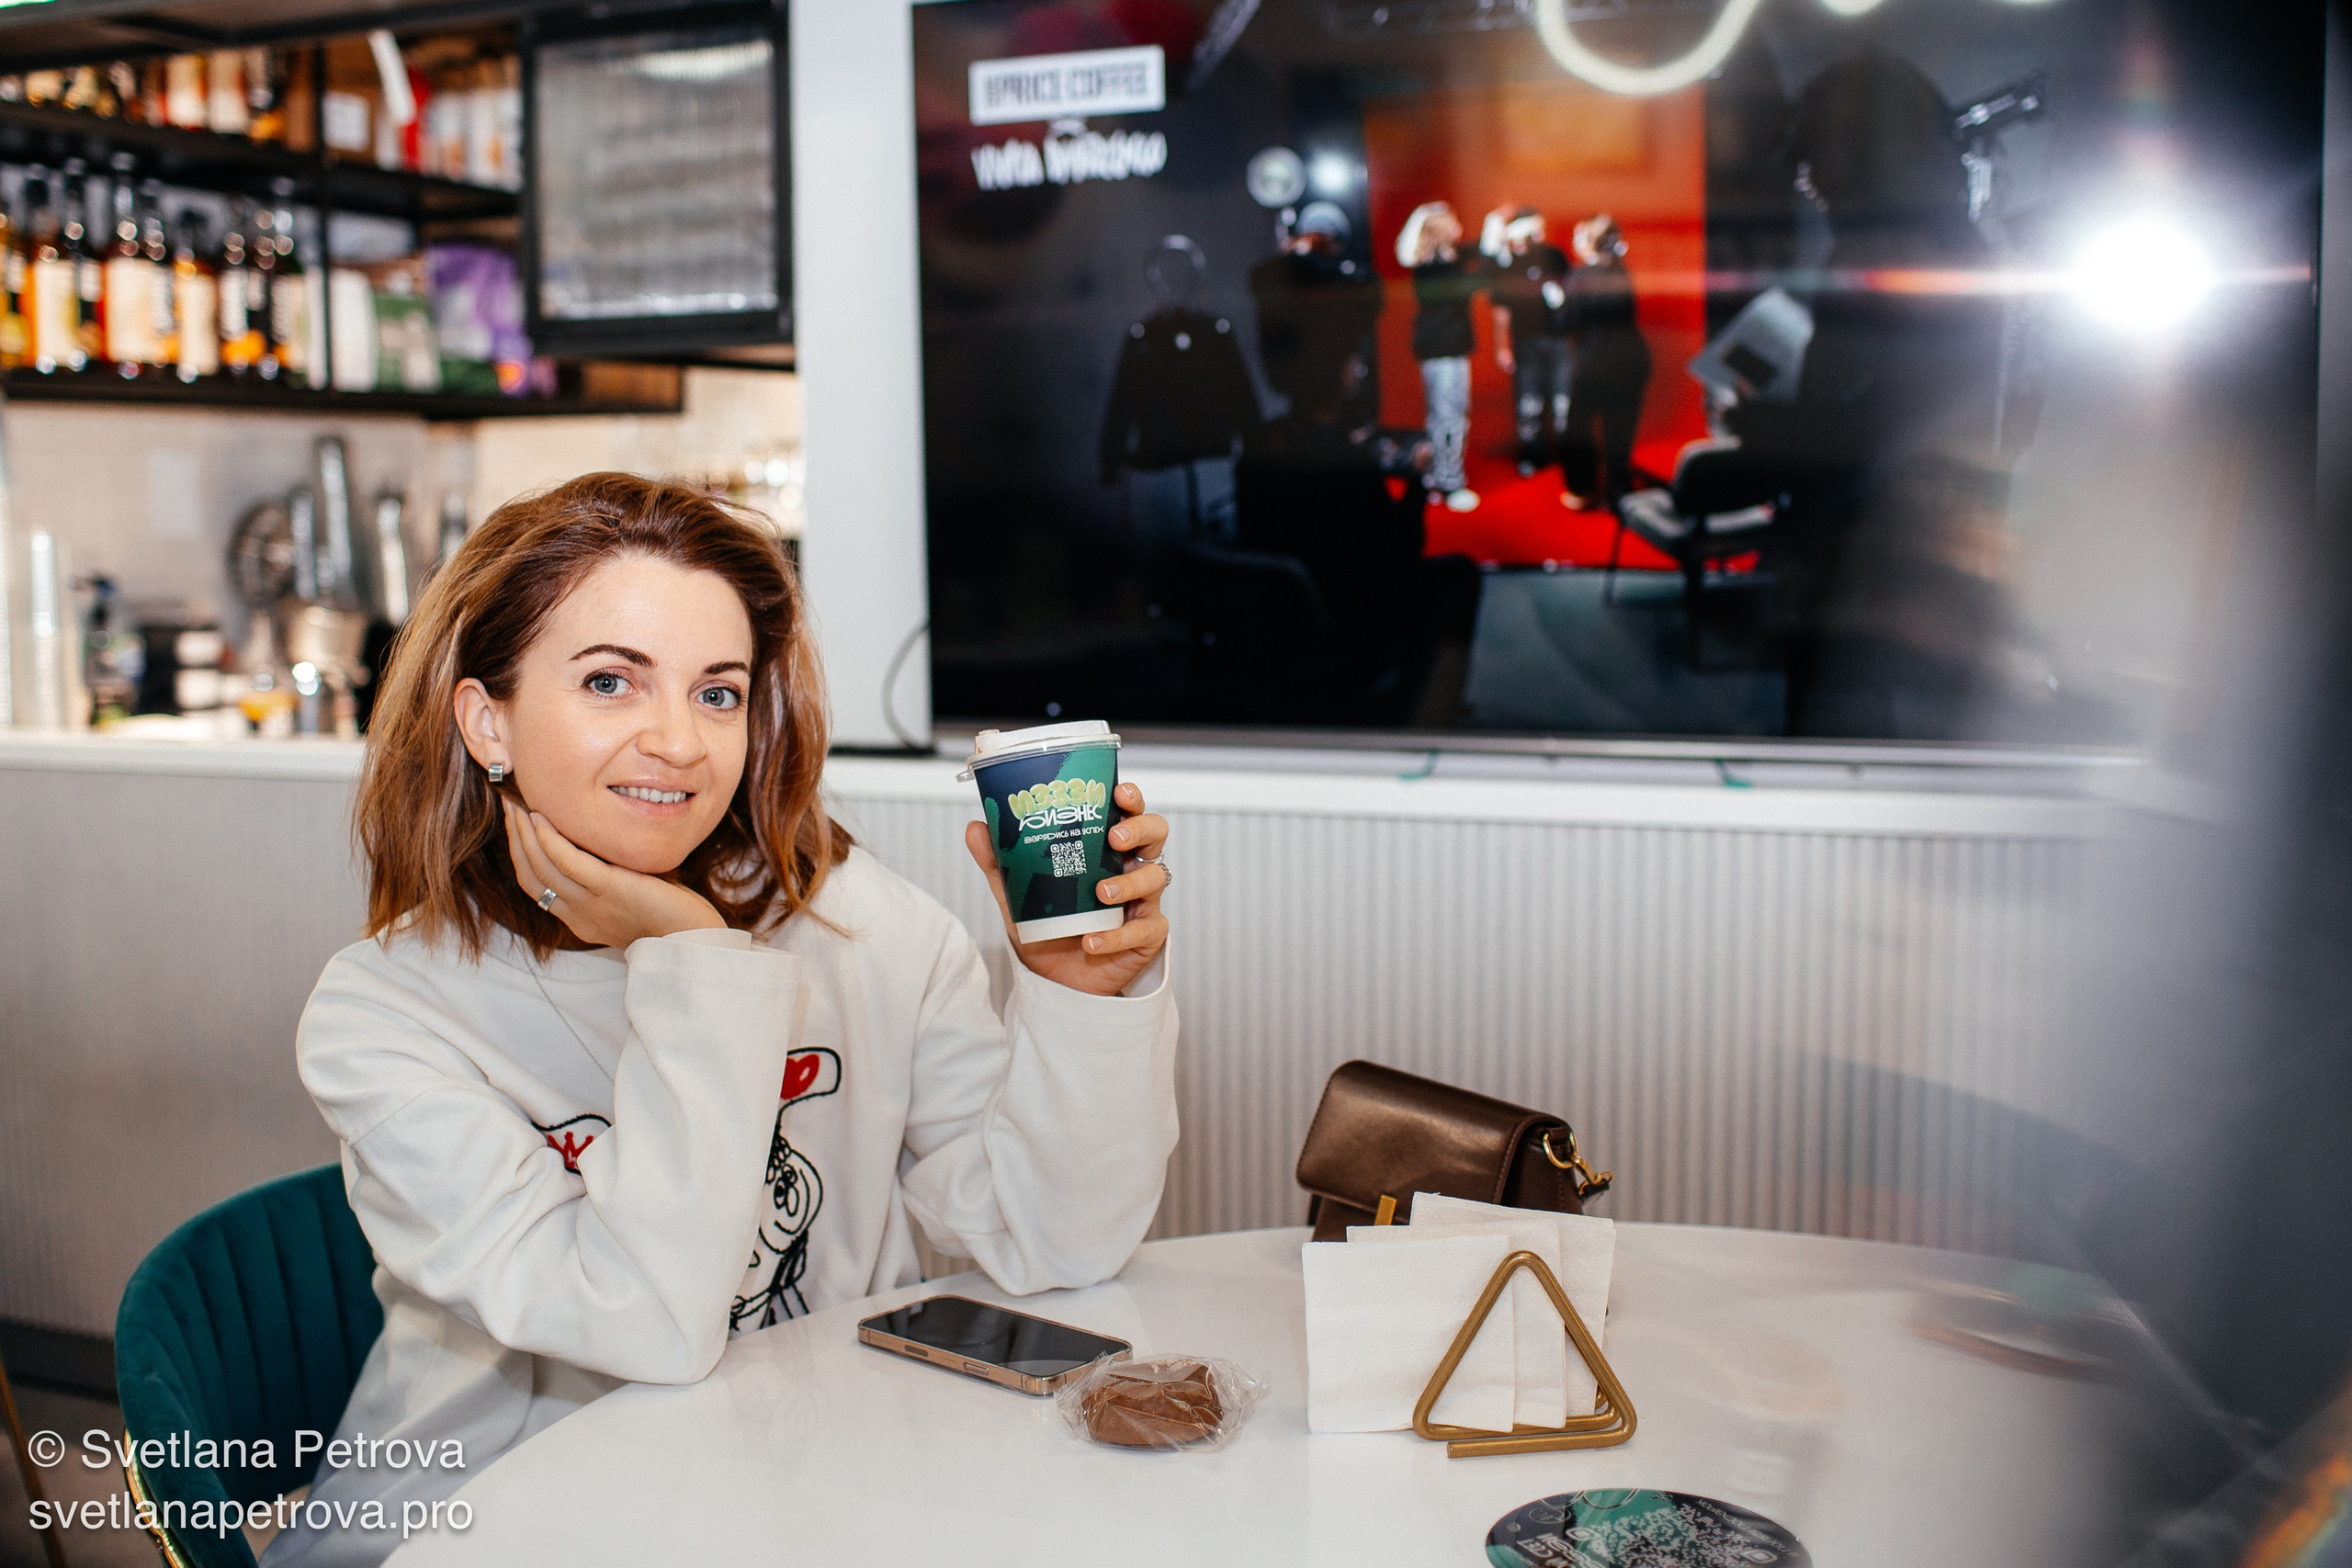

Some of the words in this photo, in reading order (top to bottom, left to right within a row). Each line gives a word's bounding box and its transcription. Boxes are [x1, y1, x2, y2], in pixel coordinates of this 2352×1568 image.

[1008, 778, 1106, 820] ИЗЗЗИ
[1018, 805, 1102, 831] БИЗНЕС
[1081, 826, 1104, 836] УСПЕХ
